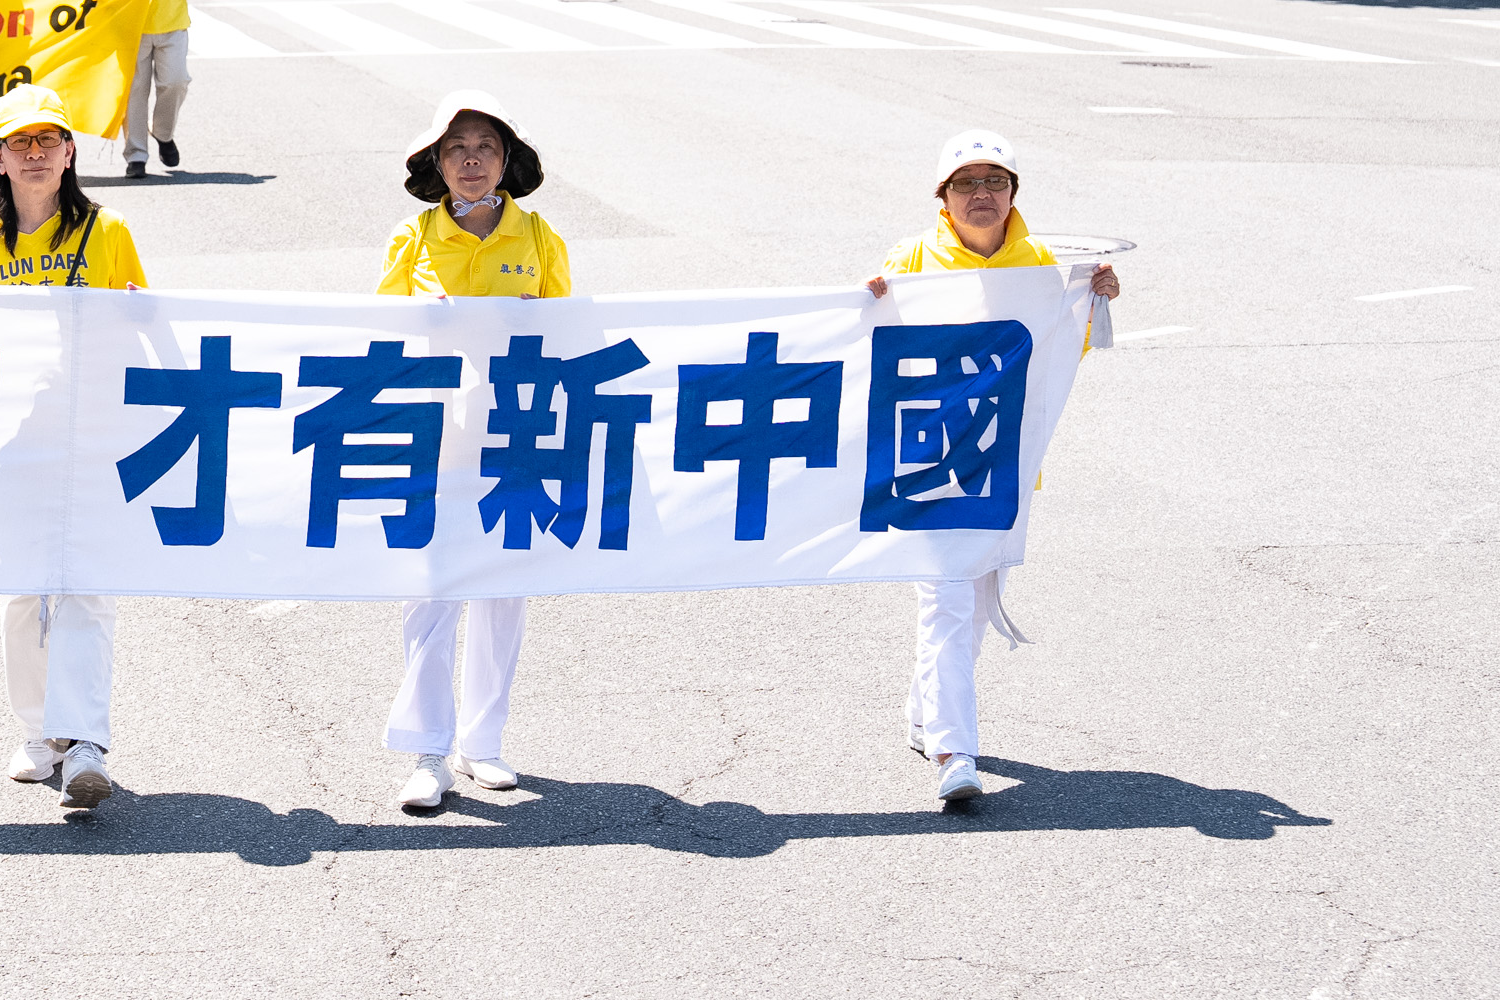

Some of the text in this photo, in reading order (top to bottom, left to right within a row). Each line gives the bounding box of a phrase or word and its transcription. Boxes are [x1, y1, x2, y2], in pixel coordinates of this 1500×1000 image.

[40, 253, 89, 271] DAFA
[116, 319, 1034, 551] 才有新中國
